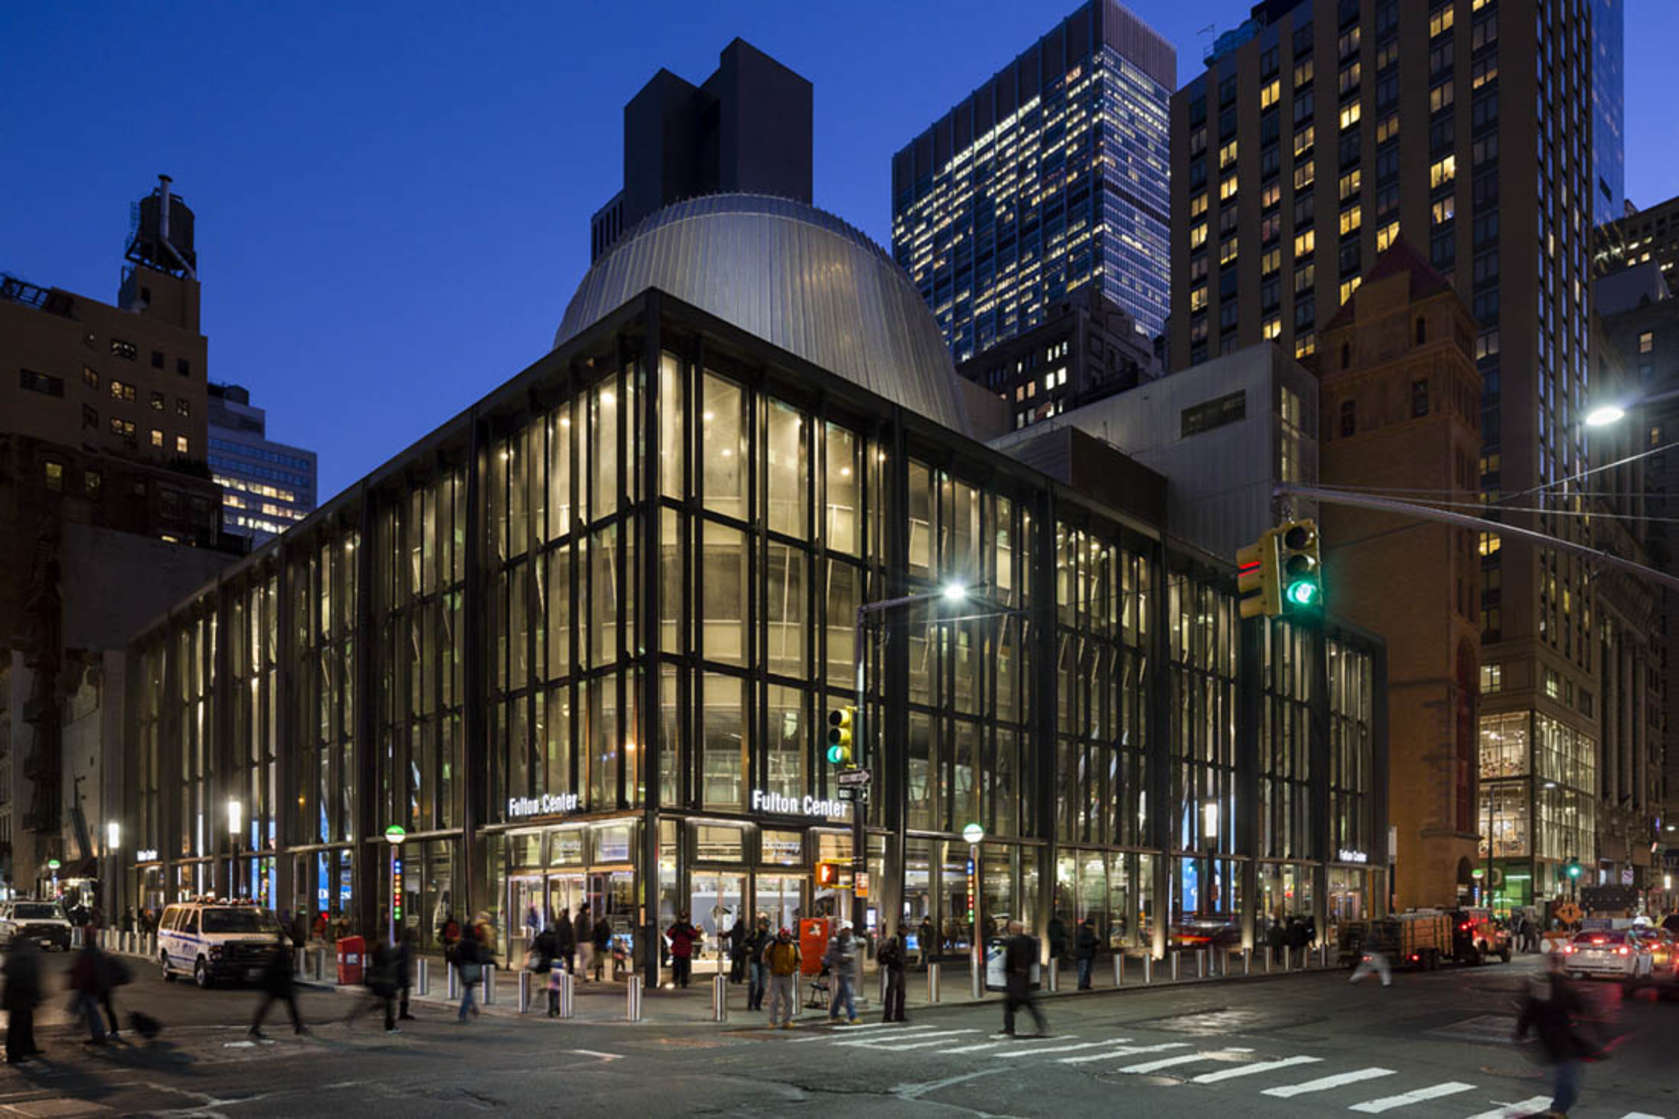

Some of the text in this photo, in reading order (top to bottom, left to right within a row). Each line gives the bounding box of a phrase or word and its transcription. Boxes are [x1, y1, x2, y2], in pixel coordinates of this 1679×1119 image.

[509, 793, 577, 816] Fulton Center
[753, 790, 847, 817] Fulton Center
